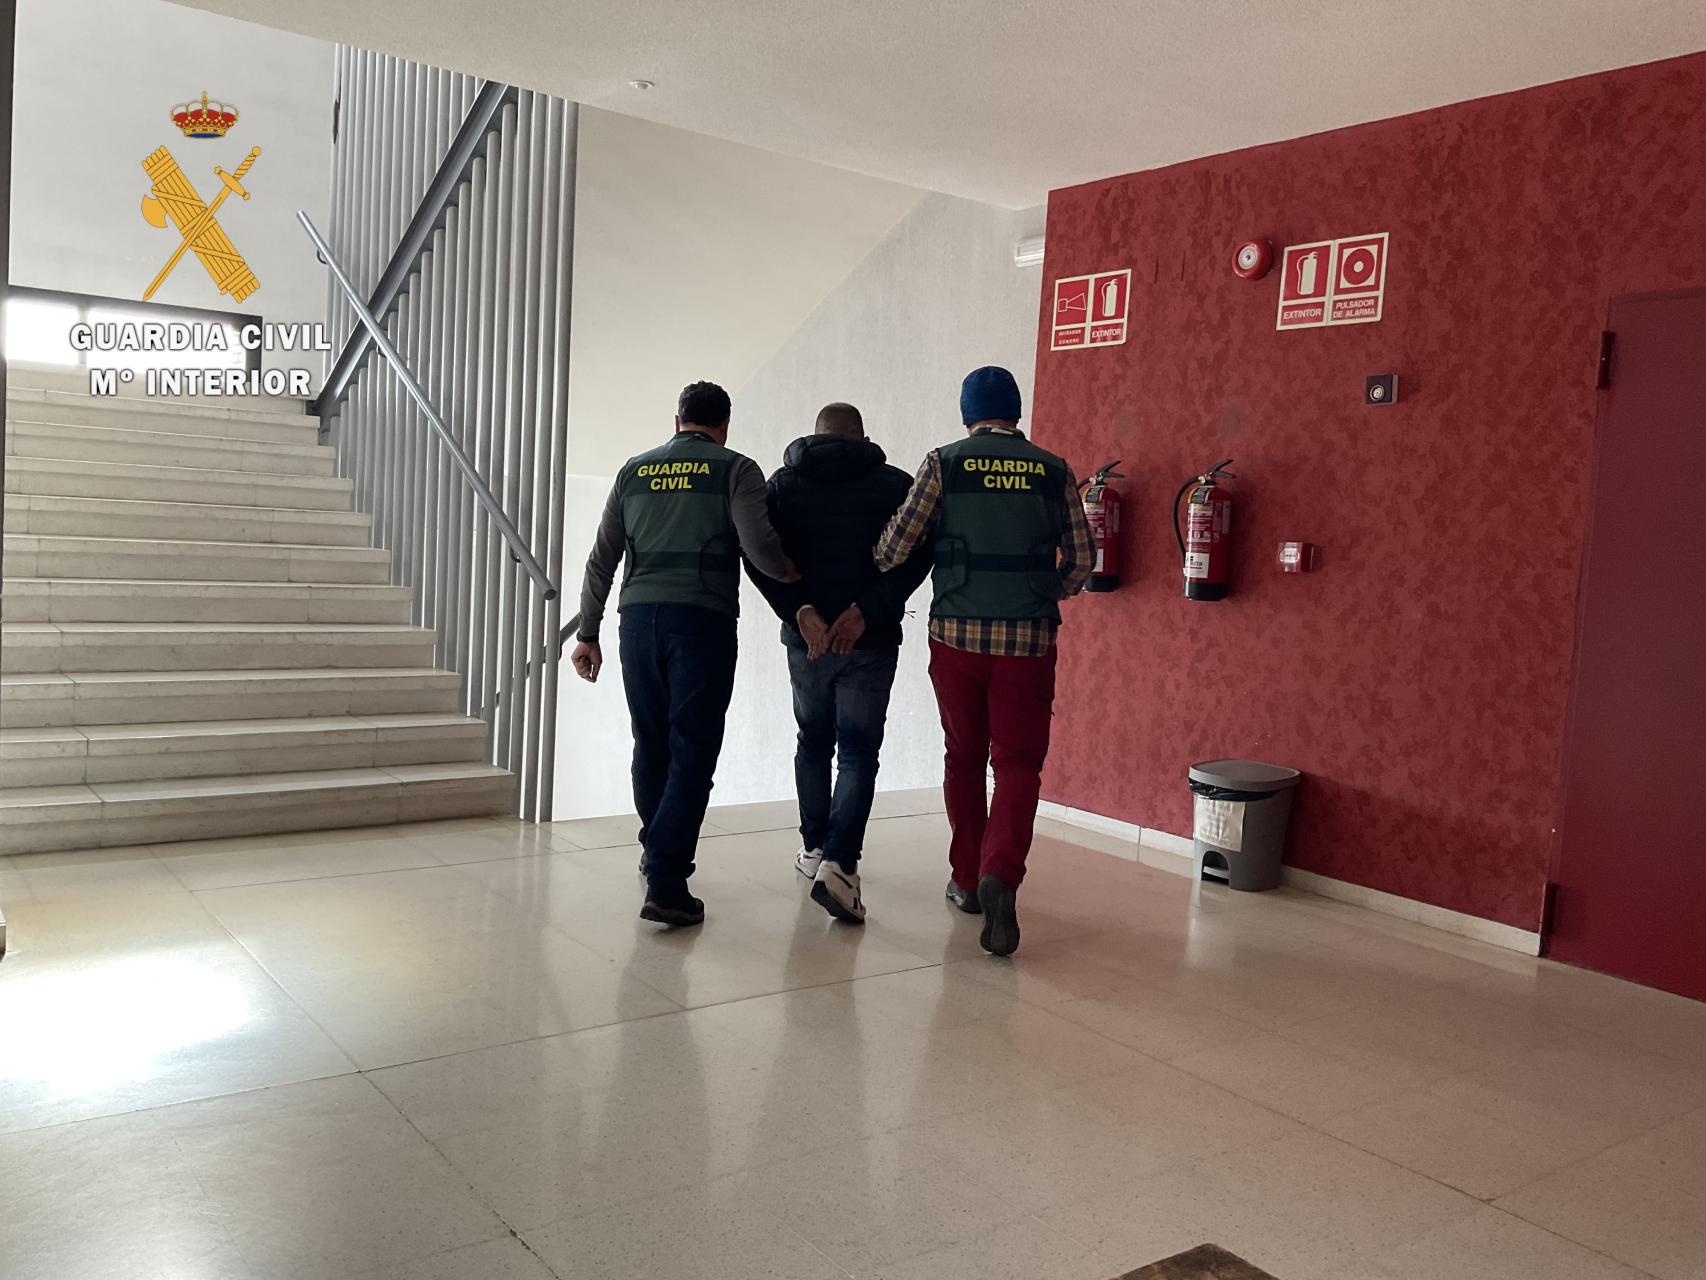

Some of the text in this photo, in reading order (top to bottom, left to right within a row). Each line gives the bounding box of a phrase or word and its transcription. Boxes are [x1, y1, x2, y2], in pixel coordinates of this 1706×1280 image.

[1336, 299, 1375, 310] PULSADOR
[1283, 308, 1322, 320] EXTINTOR
[1333, 307, 1376, 319] DE ALARMA
[1092, 328, 1121, 338] EXTINTOR
[637, 462, 710, 477] GUARDIA
[963, 458, 1046, 476] GUARDIA
[650, 476, 692, 490] CIVIL
[983, 475, 1031, 489] CIVIL
